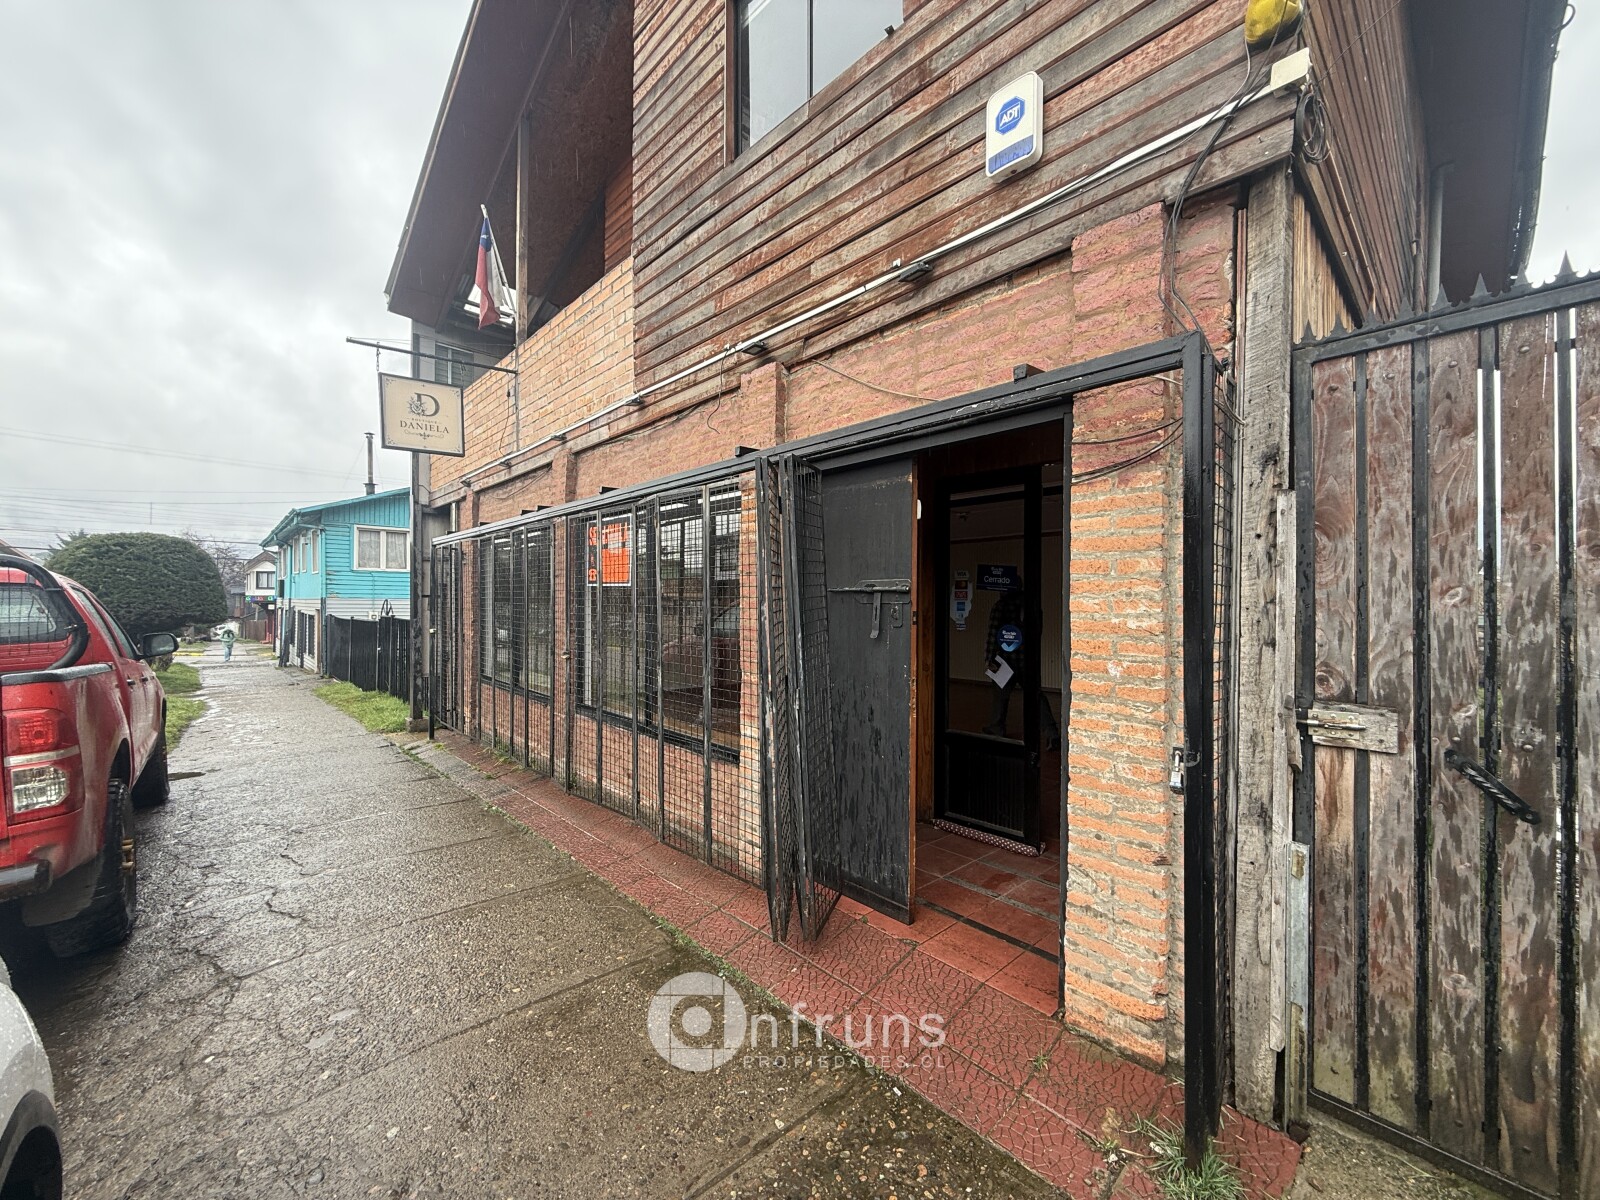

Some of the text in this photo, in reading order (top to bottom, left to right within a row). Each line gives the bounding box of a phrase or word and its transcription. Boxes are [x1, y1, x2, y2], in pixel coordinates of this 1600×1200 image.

[1000, 104, 1020, 126] ADT
[400, 420, 449, 434] DANIELA
[983, 575, 1011, 584] Cerrado
